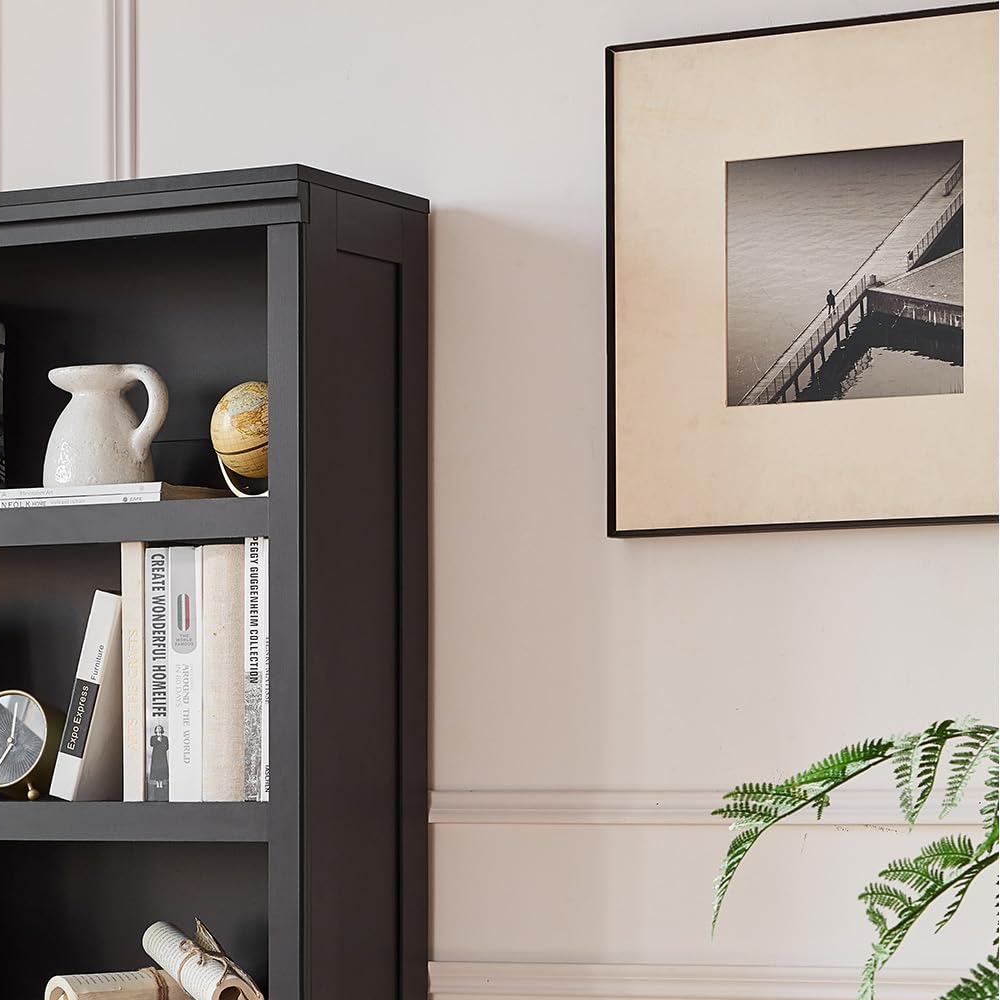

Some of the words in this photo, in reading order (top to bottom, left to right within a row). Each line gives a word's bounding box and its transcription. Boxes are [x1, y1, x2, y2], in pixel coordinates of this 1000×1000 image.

[250, 536, 258, 564] PEGGY
[151, 553, 165, 592] CREATE
[250, 567, 258, 626] GUGGENHEIM
[152, 595, 166, 661] WONDERFUL
[90, 644, 105, 681] Furniture
[250, 630, 258, 684] COLLECTION
[152, 665, 167, 717] HOMELIFE
[182, 664, 190, 704] AROUND
[73, 685, 89, 724] Express
[182, 709, 190, 726] THE
[67, 726, 80, 751] Expo
[183, 729, 191, 764] WORLD
